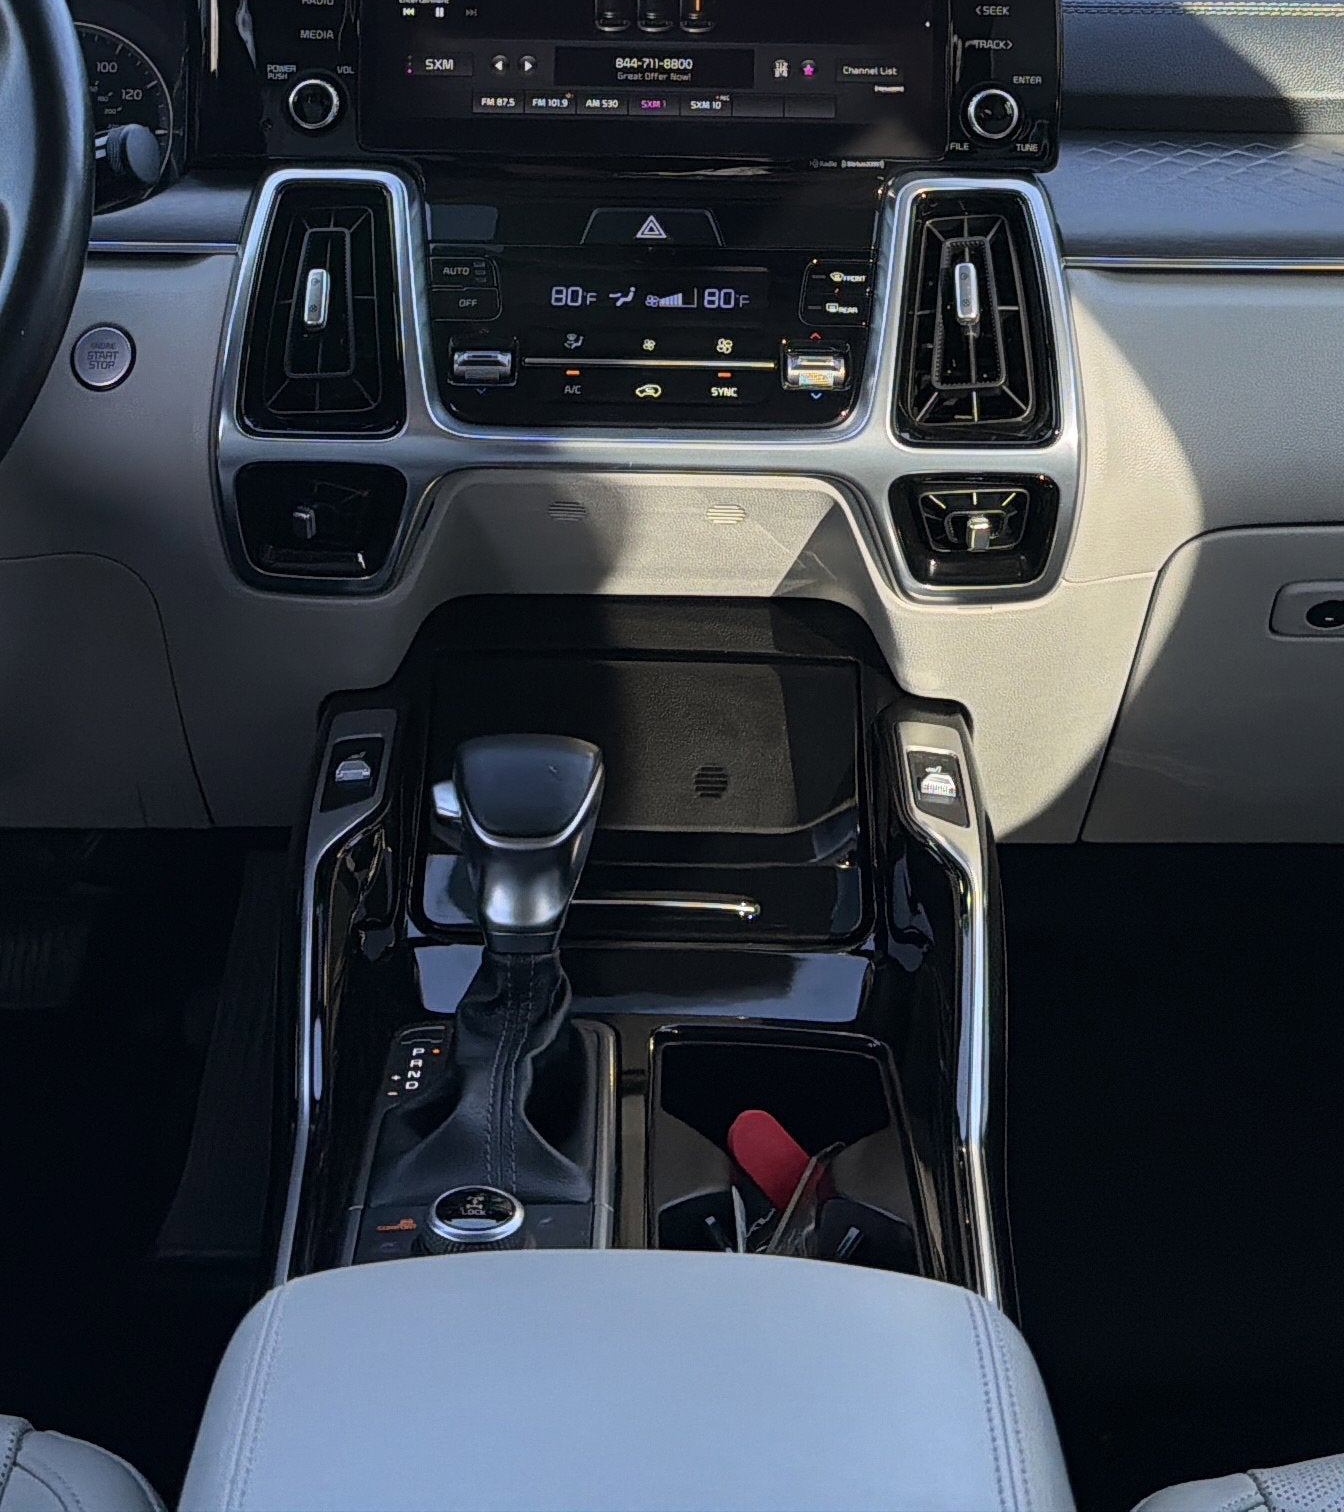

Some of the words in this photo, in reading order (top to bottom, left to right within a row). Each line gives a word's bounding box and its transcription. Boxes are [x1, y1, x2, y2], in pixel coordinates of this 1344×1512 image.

[982, 6, 1010, 16] SEEK
[299, 29, 335, 39] MEDIA
[96, 61, 118, 73] 100
[266, 64, 297, 73] POWER
[425, 58, 454, 70] SXM
[615, 58, 693, 70] 844-711-8800
[336, 65, 355, 75] VOL
[842, 65, 879, 76] Channel
[880, 66, 898, 76] List
[267, 72, 288, 80] PUSH
[617, 71, 643, 81] Great
[644, 71, 669, 81] Offer
[1012, 75, 1042, 85] ENTER
[121, 88, 143, 101] 120
[481, 98, 496, 106] FM
[532, 99, 546, 107] FM
[585, 99, 601, 108] AM
[601, 99, 619, 109] 530
[640, 100, 662, 109] SXM
[690, 100, 710, 110] SXM
[712, 100, 722, 110] 10
[950, 142, 970, 152] FILE
[1015, 143, 1039, 153] TUNE
[442, 265, 470, 276] AUTO
[458, 298, 478, 308] OFF
[87, 350, 119, 361] START
[88, 360, 115, 370] STOP
[563, 384, 582, 396] A/C
[710, 386, 738, 398] SYNC
[412, 1047, 425, 1057] P
[407, 1070, 421, 1079] N
[405, 1081, 419, 1090] D
